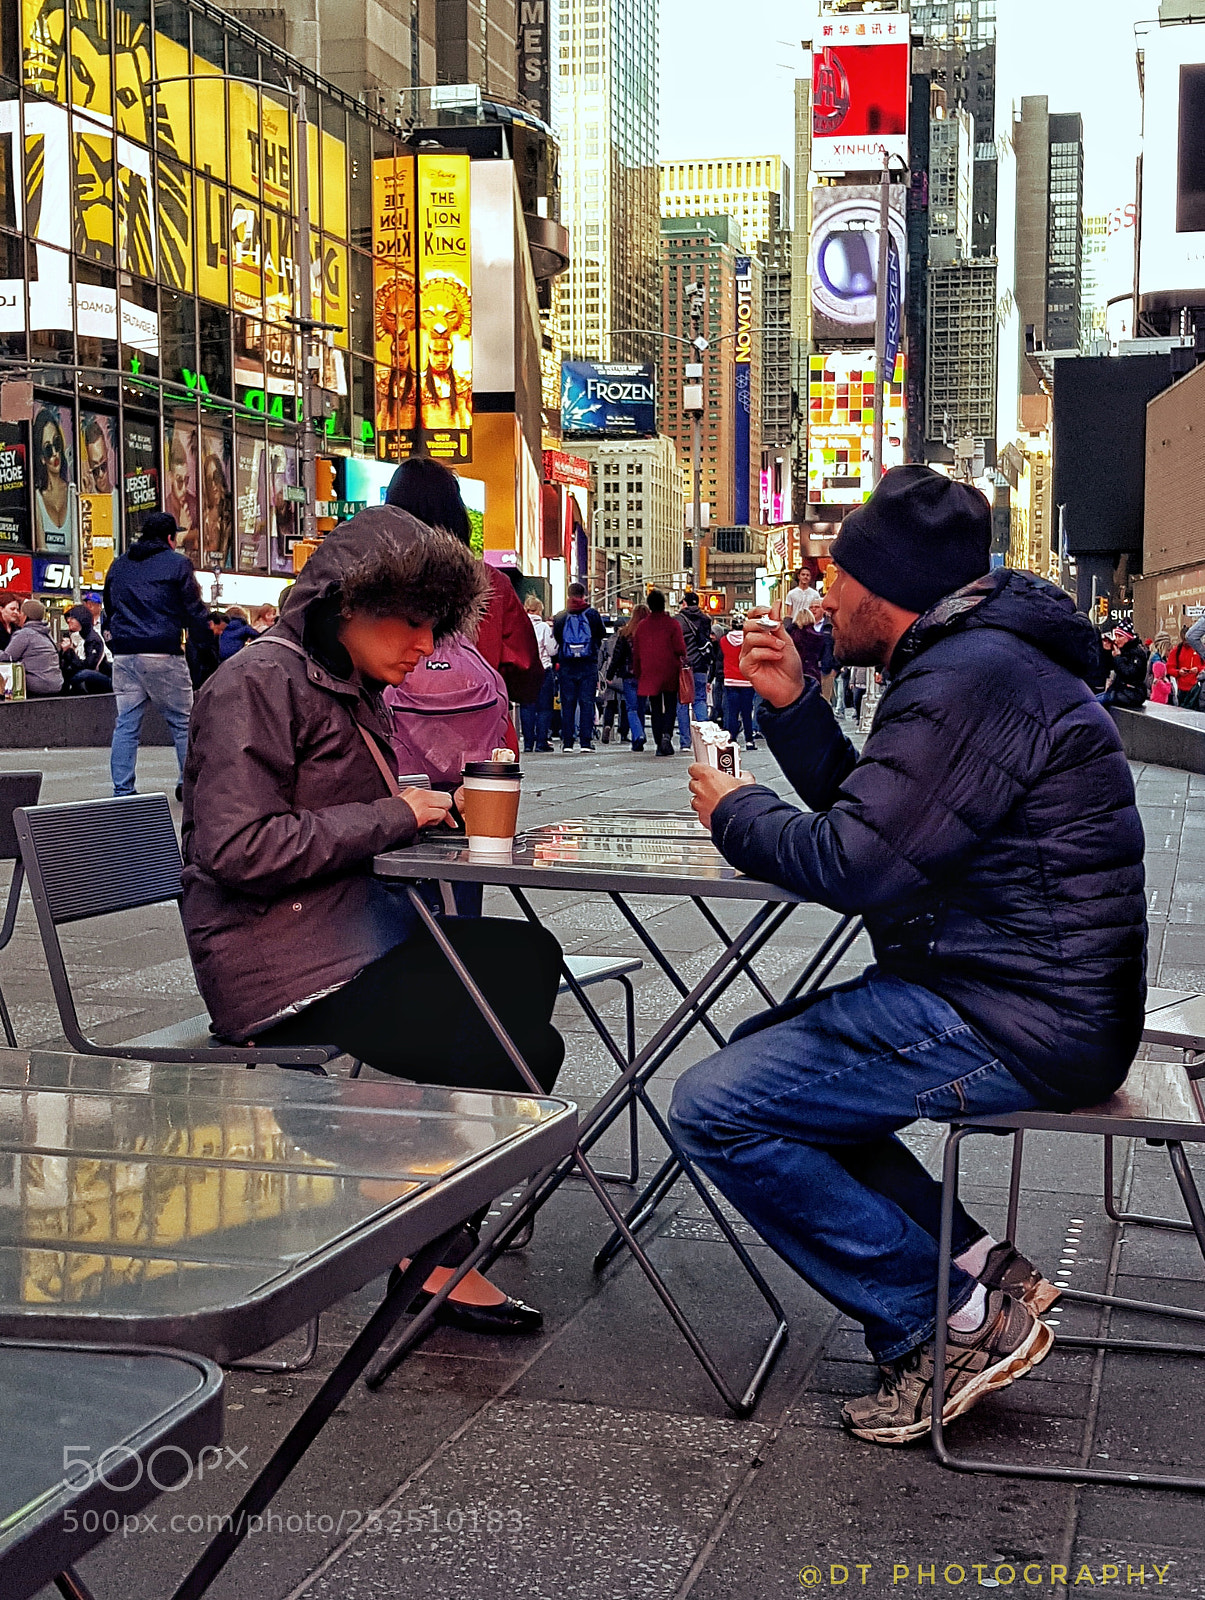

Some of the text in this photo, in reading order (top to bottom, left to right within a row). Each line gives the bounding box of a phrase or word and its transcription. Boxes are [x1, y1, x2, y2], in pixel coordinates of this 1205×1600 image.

[247, 128, 289, 190] THE
[833, 143, 886, 156] XINHUA
[430, 192, 455, 205] THE
[426, 208, 460, 228] LION
[424, 231, 466, 256] KING
[735, 265, 752, 363] NOVOTEL
[886, 250, 898, 363] FROZEN
[586, 378, 654, 404] FROZEN
[126, 475, 151, 493] JERSEY
[133, 487, 156, 504] SHORE
[330, 503, 339, 514] W
[343, 502, 355, 514] 44
